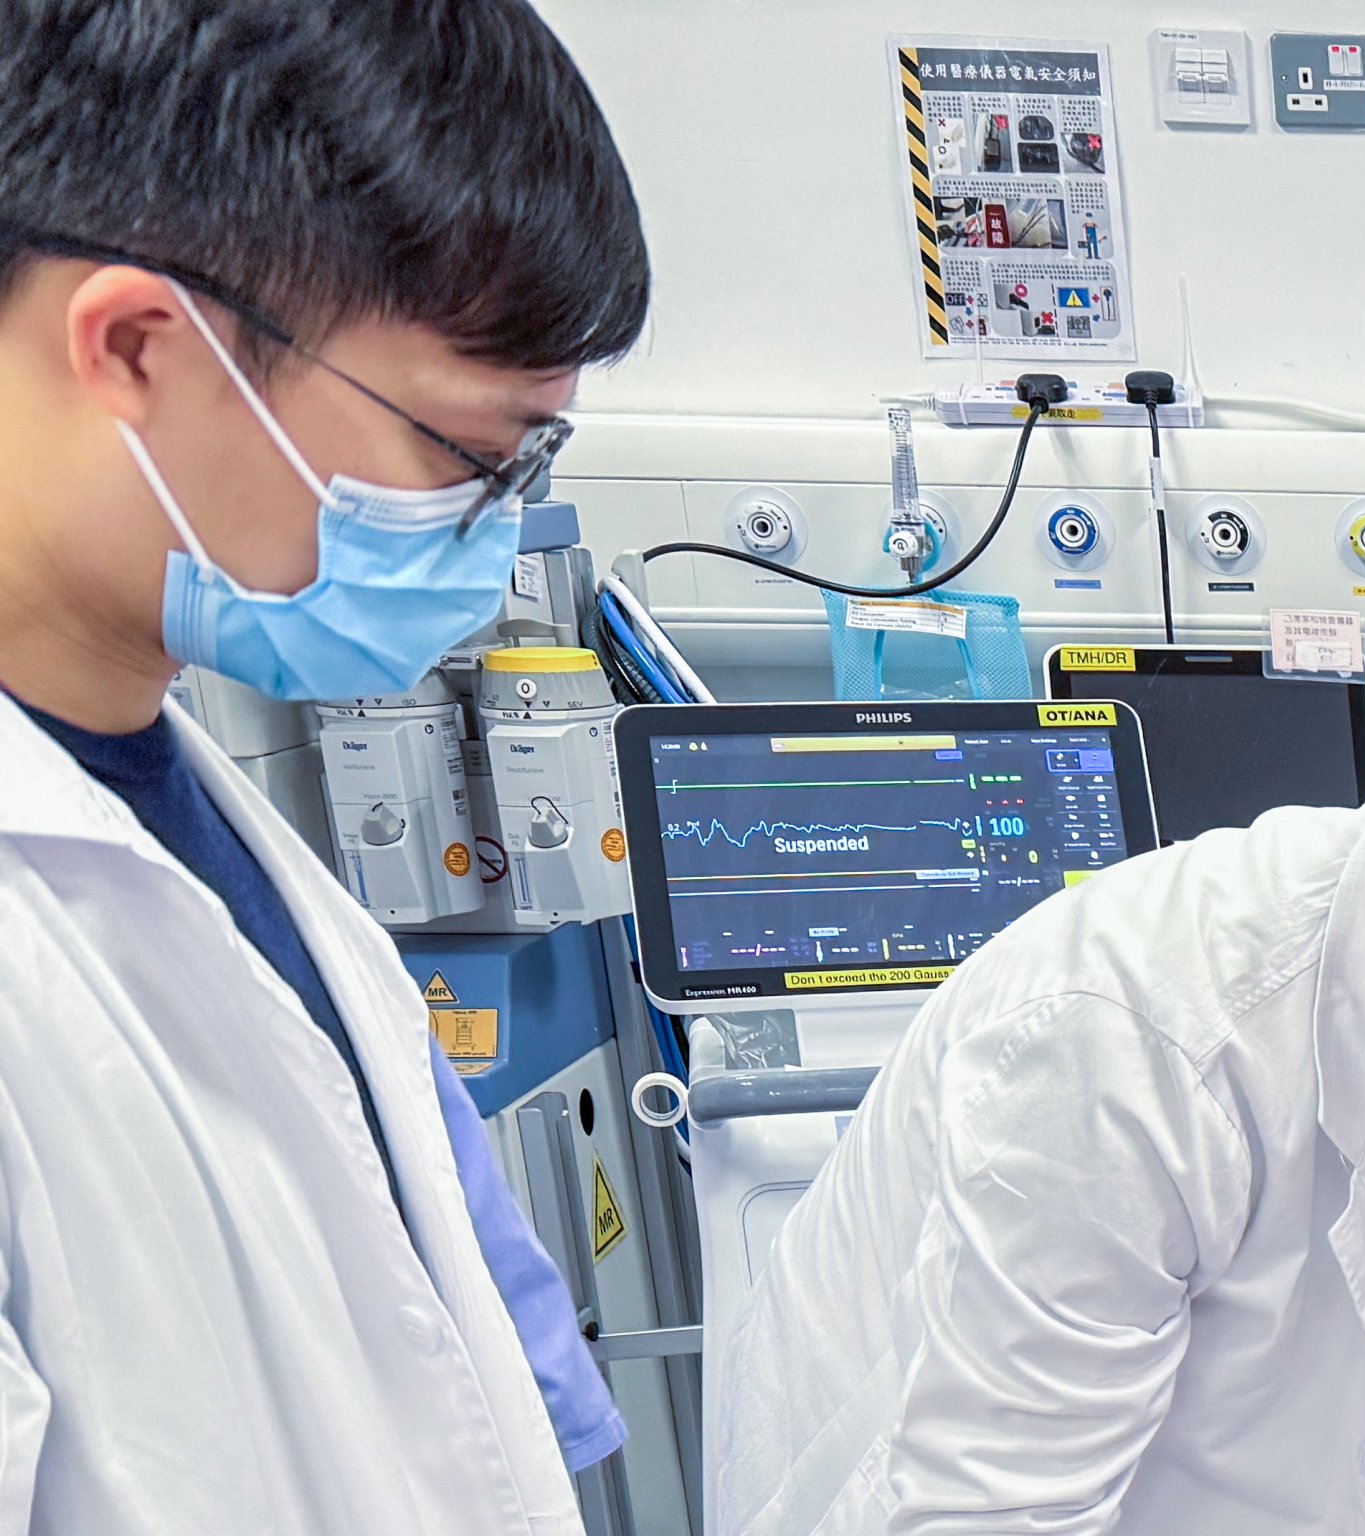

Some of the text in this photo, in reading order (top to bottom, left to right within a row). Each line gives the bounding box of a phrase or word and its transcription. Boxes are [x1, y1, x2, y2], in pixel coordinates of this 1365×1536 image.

[1066, 650, 1128, 666] TMH/DR
[855, 712, 913, 724] PHILIPS
[1046, 709, 1109, 722] OT/ANA
[989, 817, 1025, 836] 100
[773, 836, 870, 855] Suspended
[869, 970, 887, 982] the
[889, 969, 911, 981] 200
[428, 986, 448, 997] MR
[727, 985, 757, 996] MR400
[598, 1206, 615, 1236] MR
